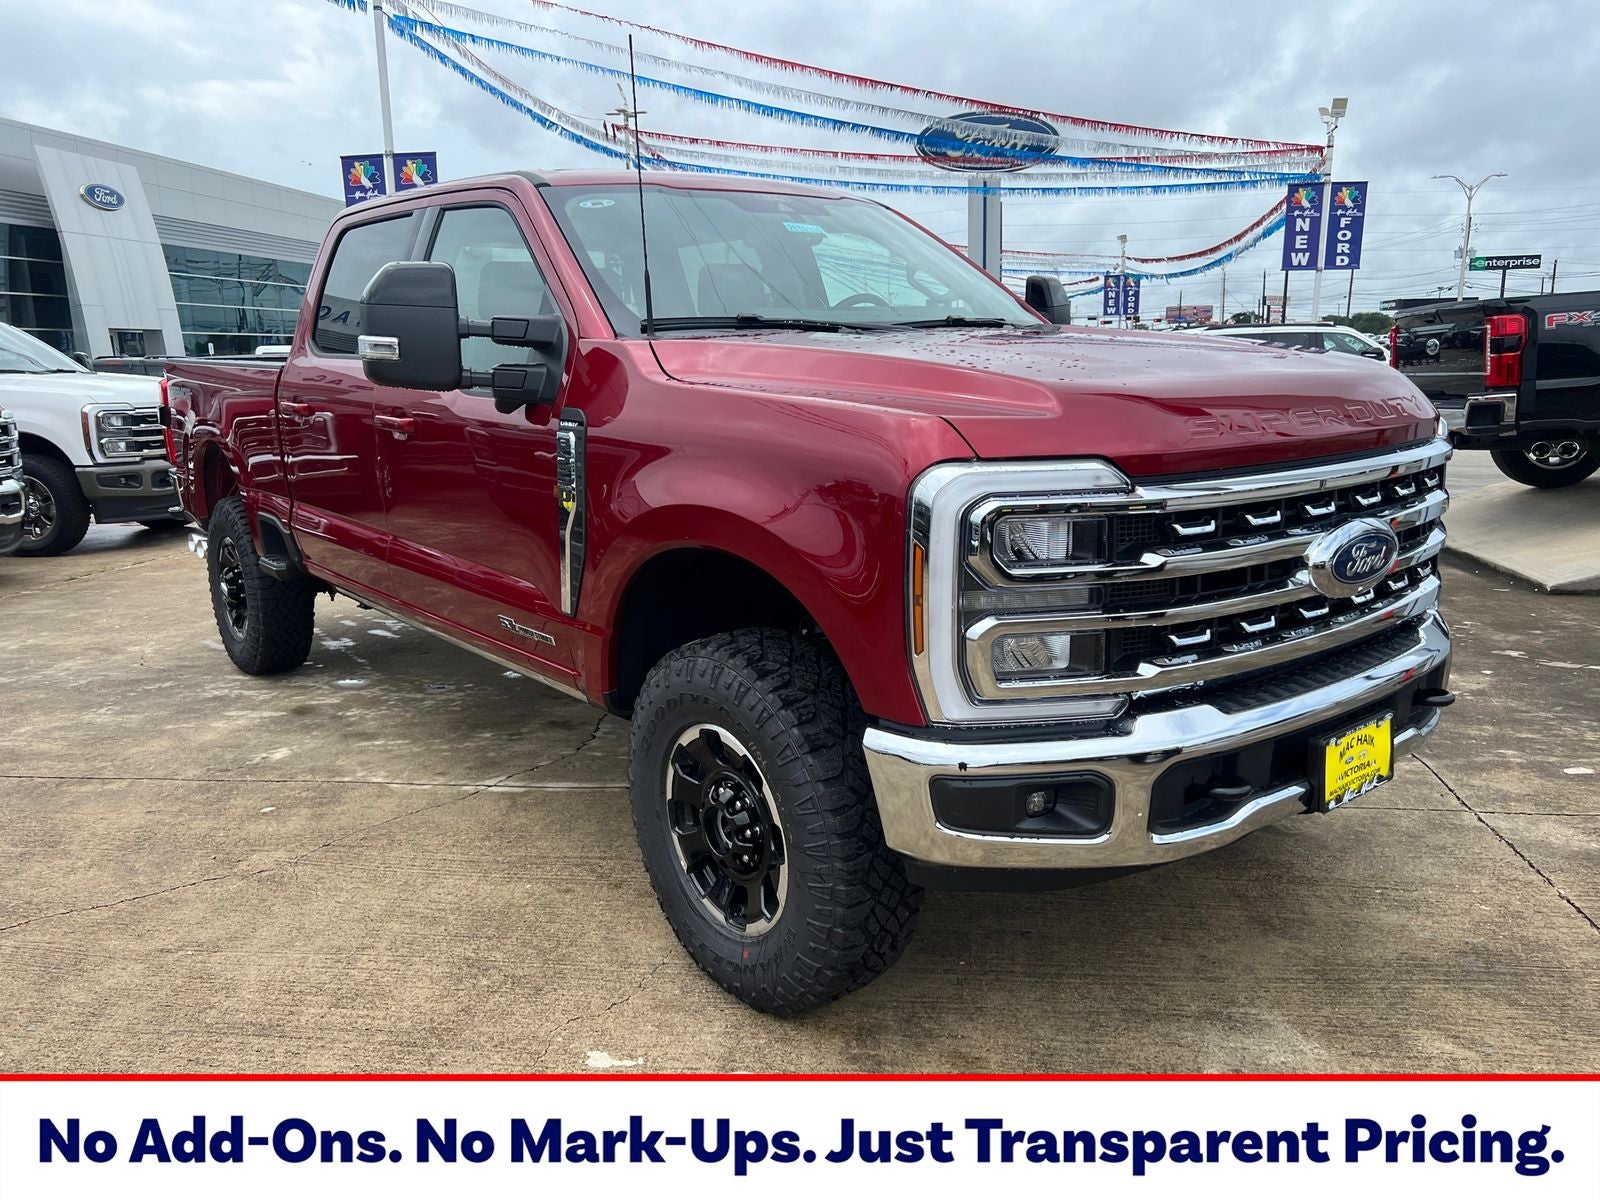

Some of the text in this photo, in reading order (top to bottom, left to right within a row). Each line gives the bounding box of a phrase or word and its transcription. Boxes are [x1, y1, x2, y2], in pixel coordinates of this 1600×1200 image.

[94, 187, 118, 205] Ford
[1290, 217, 1311, 266] NEW
[1335, 217, 1352, 266] FORD
[1473, 256, 1540, 268] enterprise
[1106, 290, 1116, 314] NEW
[1127, 290, 1136, 314] FORD
[1187, 395, 1421, 438] SUPER DUTY
[1346, 541, 1387, 579] Ford
[1339, 736, 1355, 761] MAC
[1356, 733, 1376, 748] HAIK
